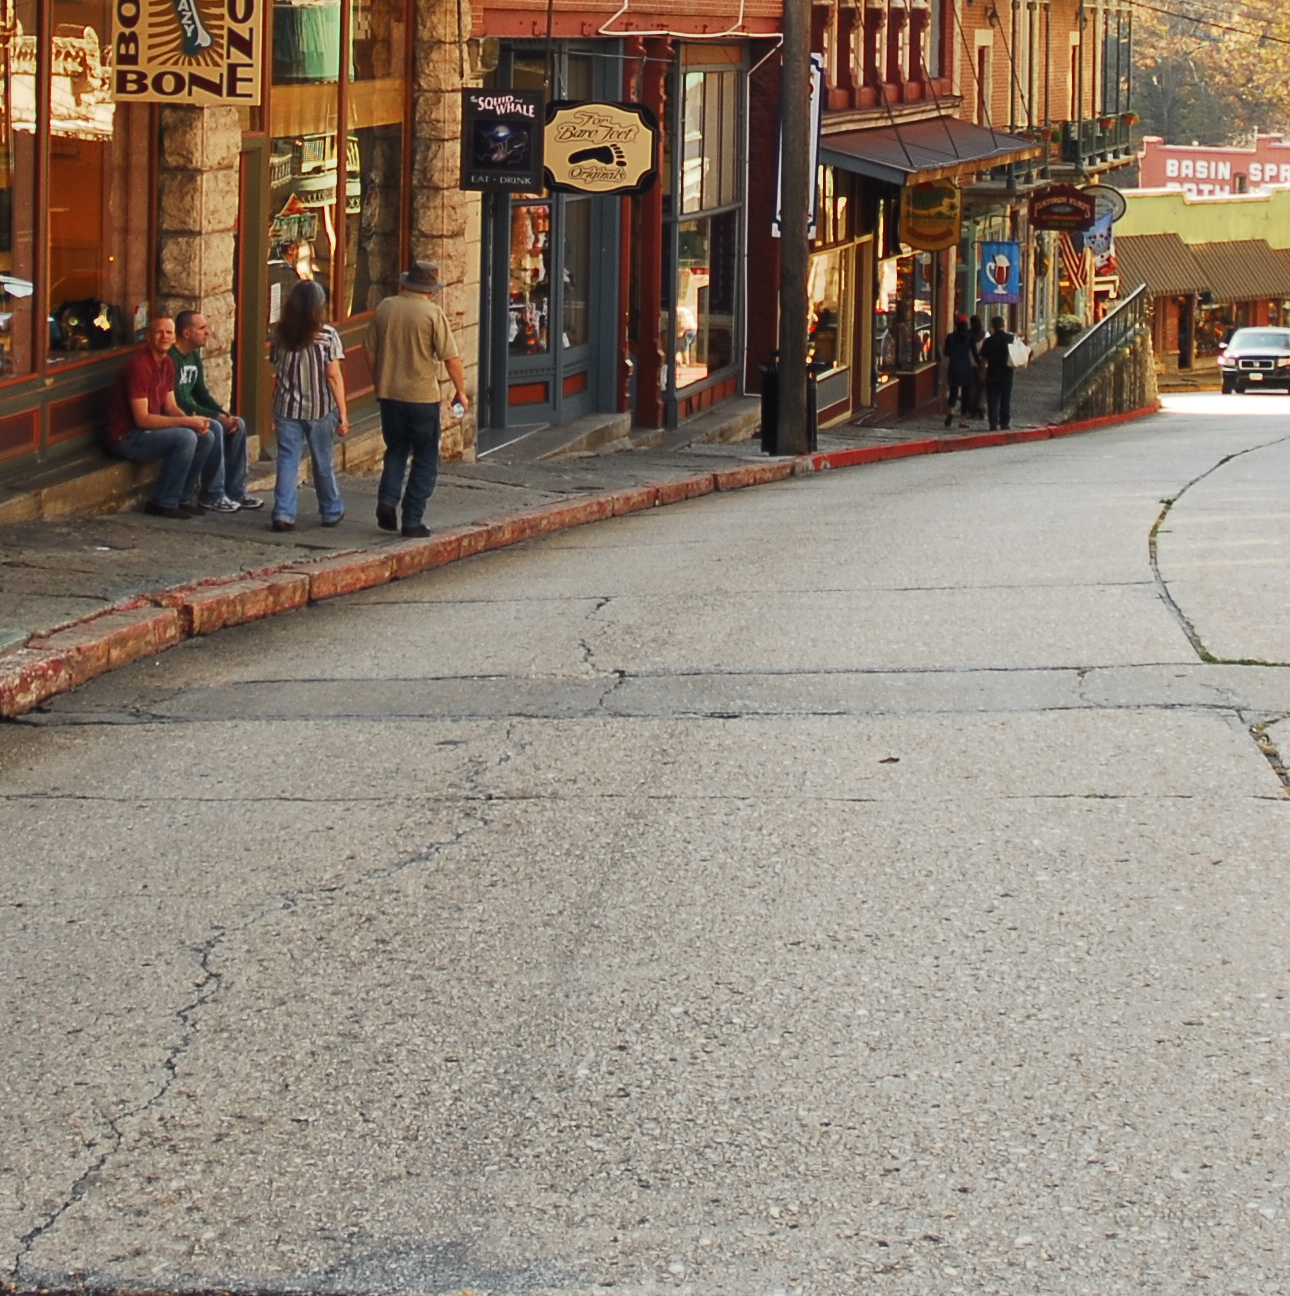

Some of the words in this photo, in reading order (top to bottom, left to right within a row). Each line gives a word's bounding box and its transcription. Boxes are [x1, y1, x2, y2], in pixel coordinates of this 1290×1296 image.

[115, 63, 254, 99] BONE
[477, 95, 515, 111] SQUID
[495, 102, 536, 118] WHALE
[576, 112, 610, 127] For
[558, 125, 599, 141] Bare
[601, 124, 637, 143] Feet
[570, 167, 625, 184] Originals
[1165, 159, 1230, 180] BASIN
[471, 175, 489, 183] EAT
[499, 176, 531, 184] DRINK
